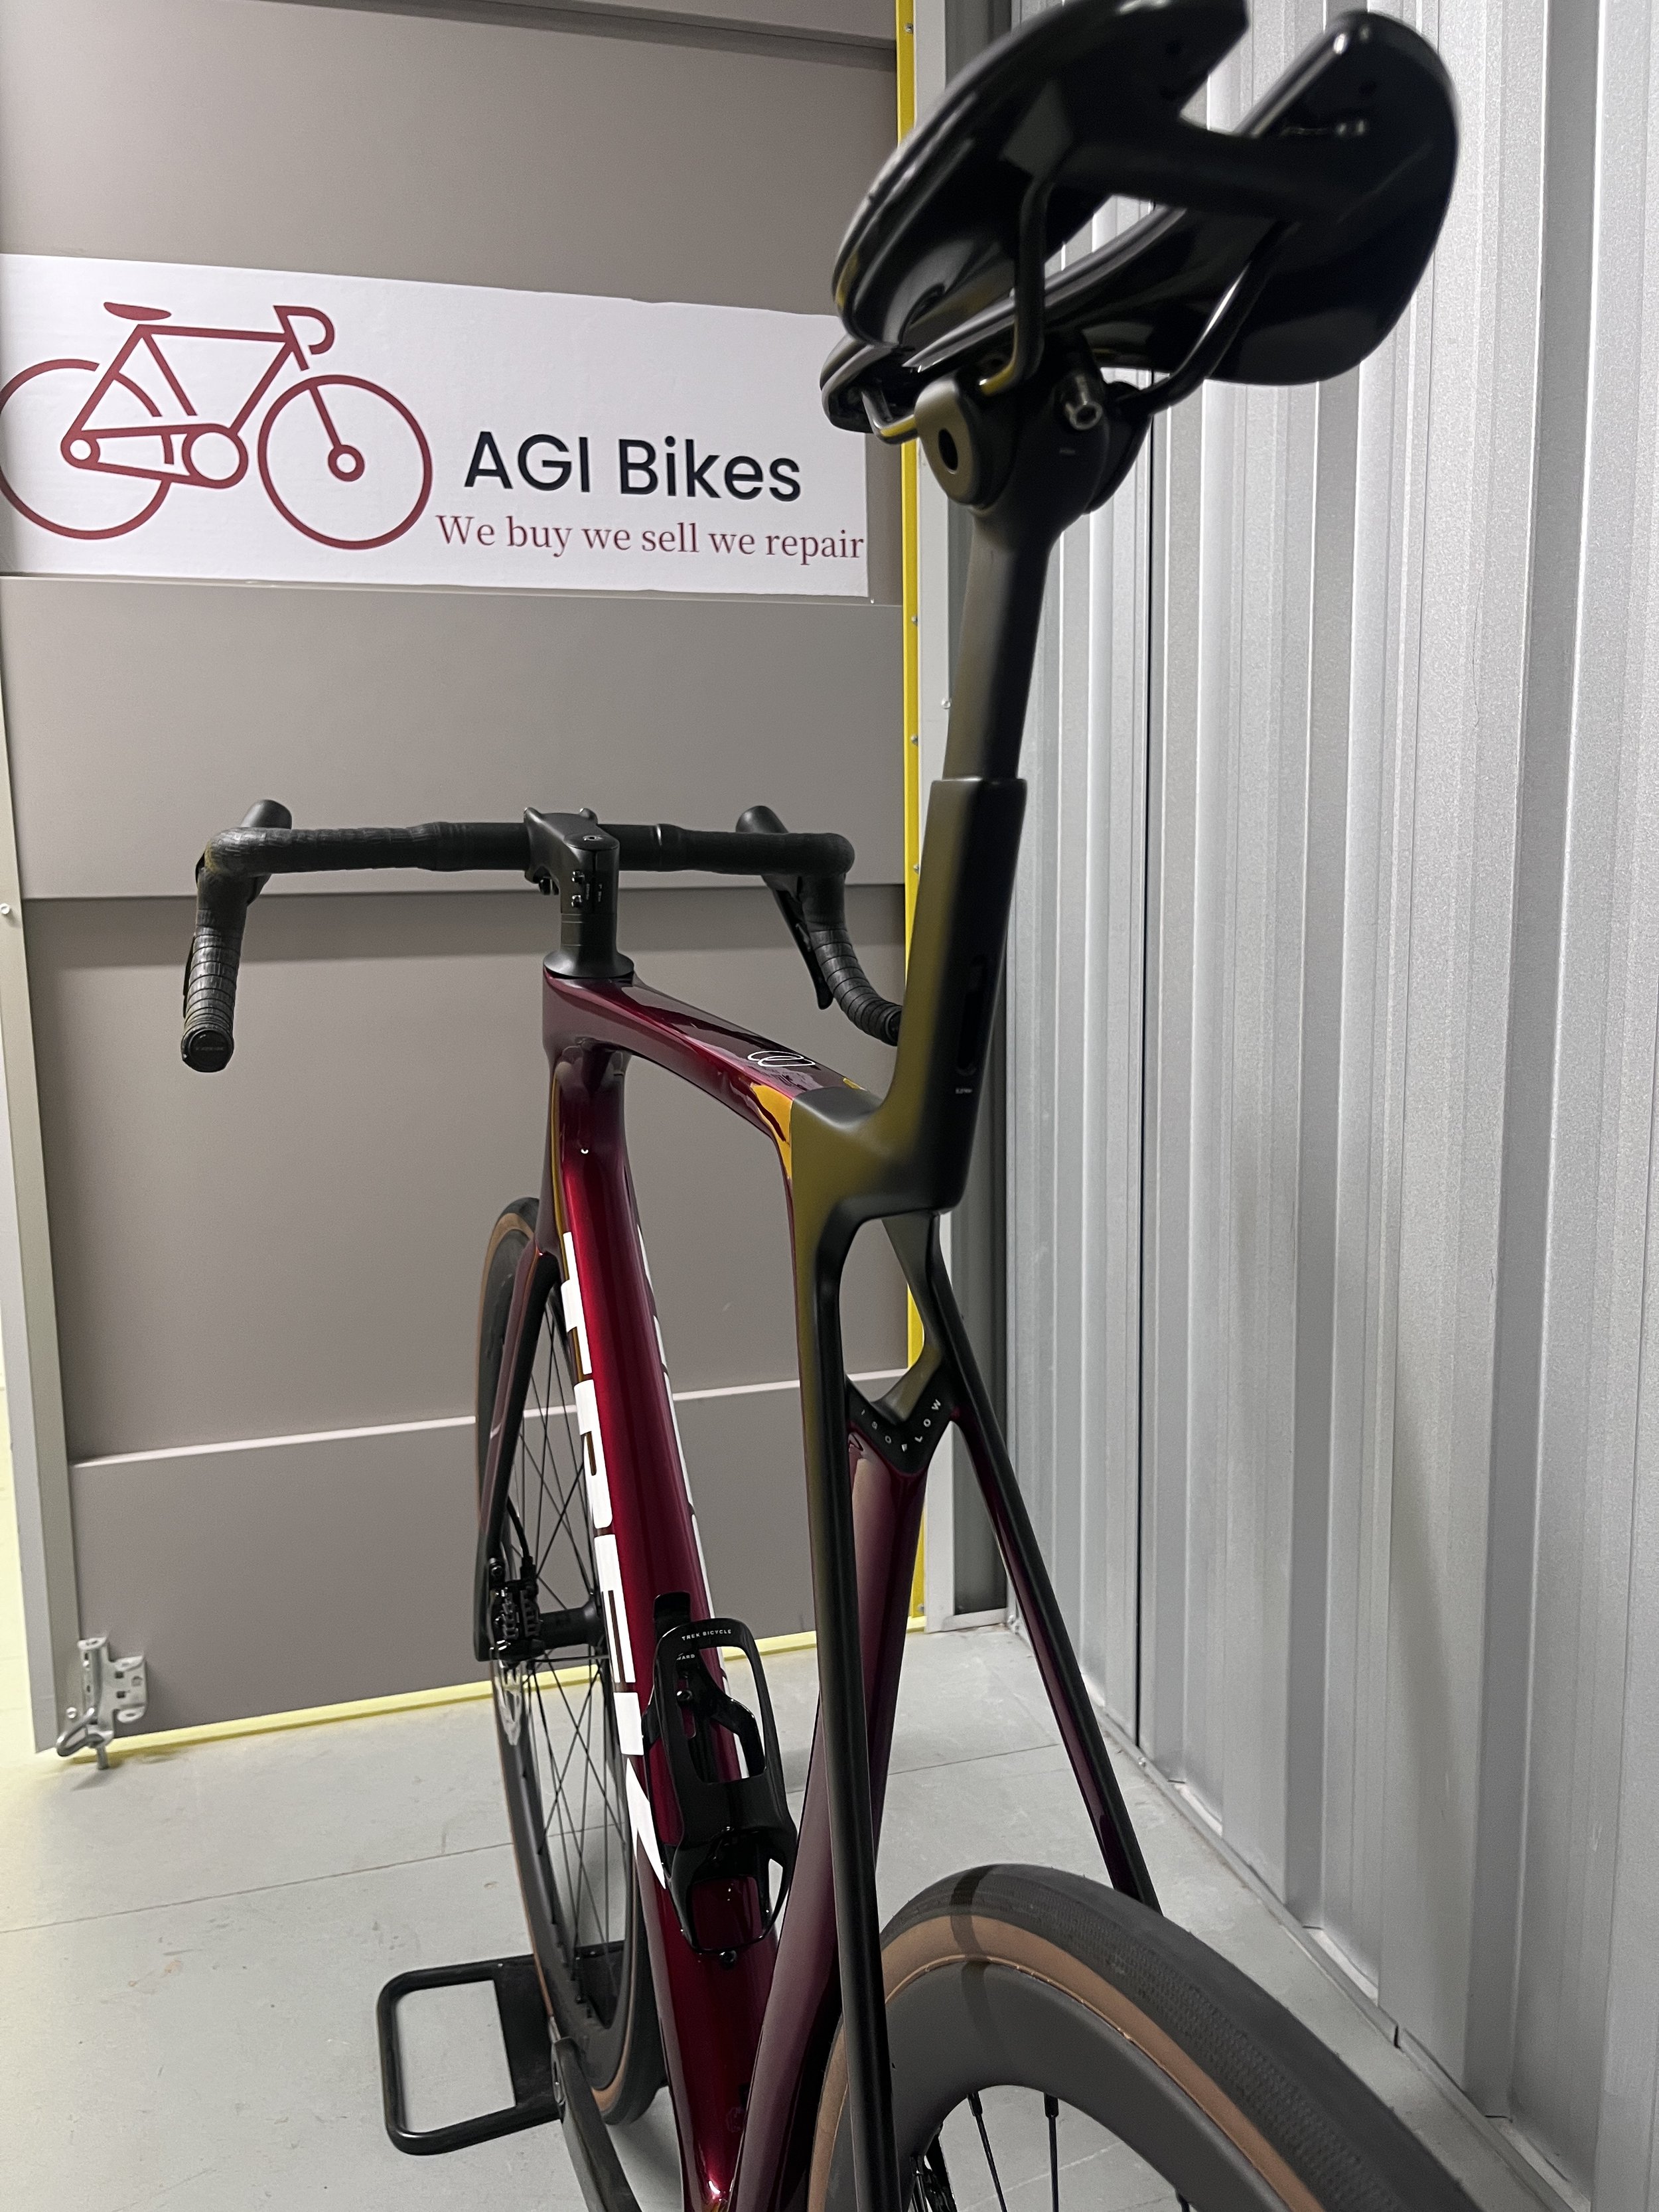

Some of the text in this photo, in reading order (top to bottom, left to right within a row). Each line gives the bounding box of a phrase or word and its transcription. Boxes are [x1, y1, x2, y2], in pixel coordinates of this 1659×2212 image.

[464, 431, 801, 502] AGI Bikes
[435, 514, 864, 565] We buy we sell we repair
